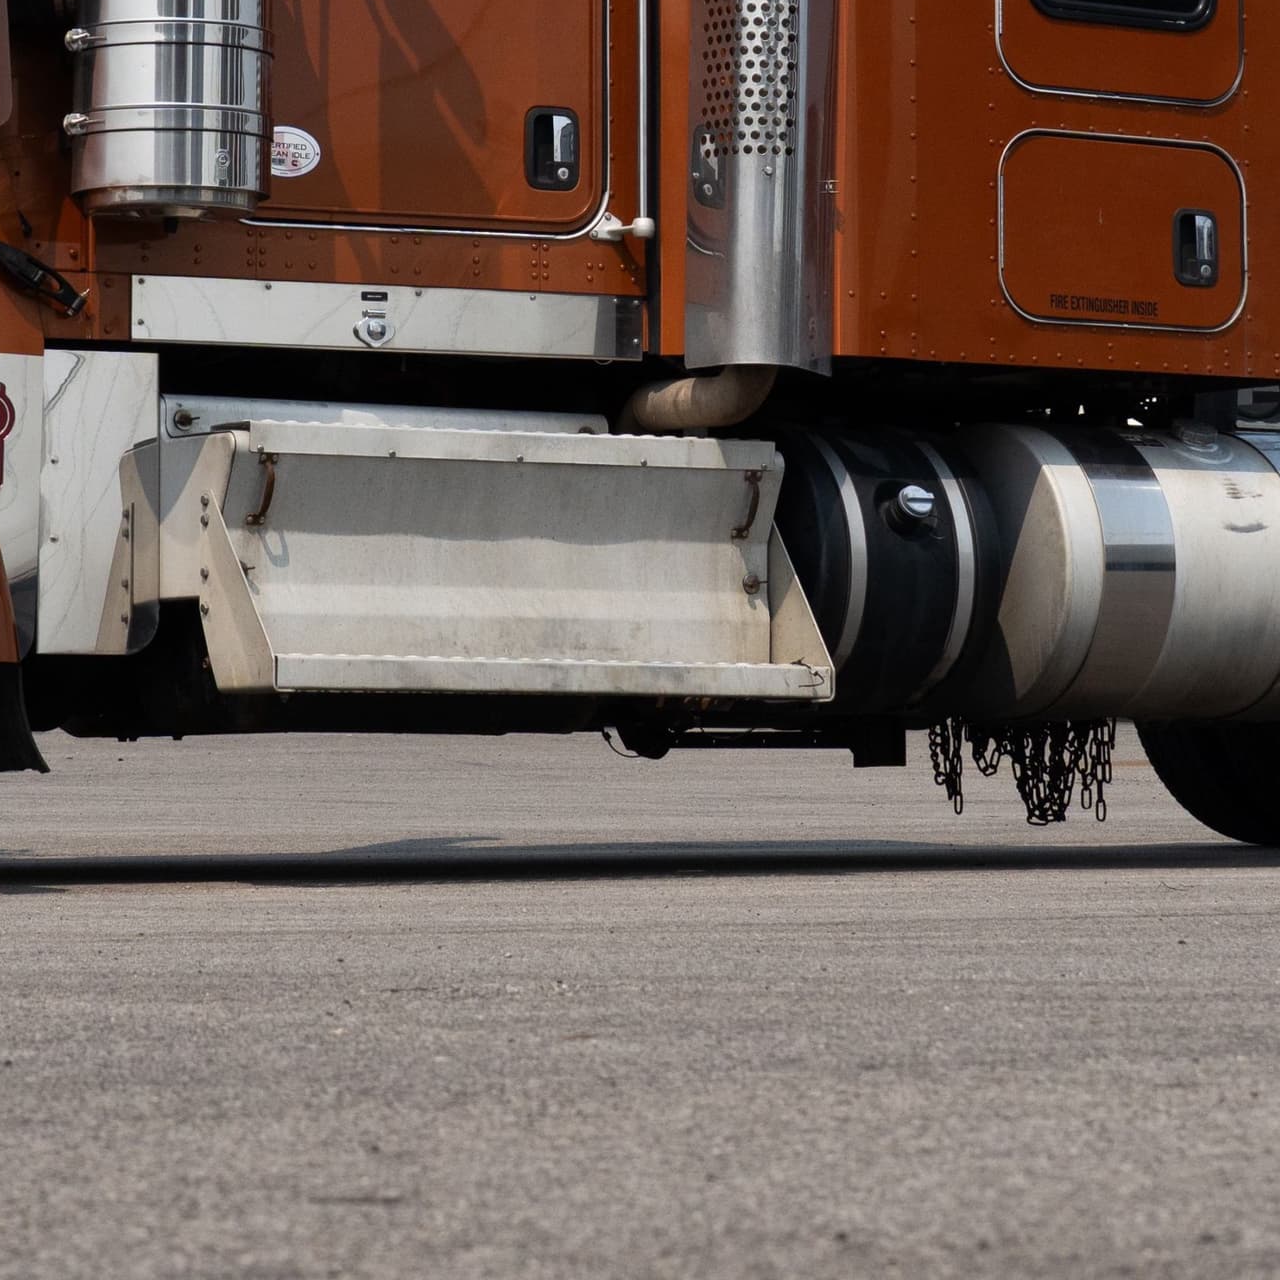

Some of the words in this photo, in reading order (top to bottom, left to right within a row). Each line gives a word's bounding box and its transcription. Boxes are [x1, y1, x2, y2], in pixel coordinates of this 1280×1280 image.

[271, 142, 307, 151] ERTIFIED
[292, 151, 311, 160] IDLE
[1050, 294, 1069, 309] FIRE
[1070, 295, 1130, 314] EXTINGUISHER
[1131, 300, 1158, 316] INSIDE
